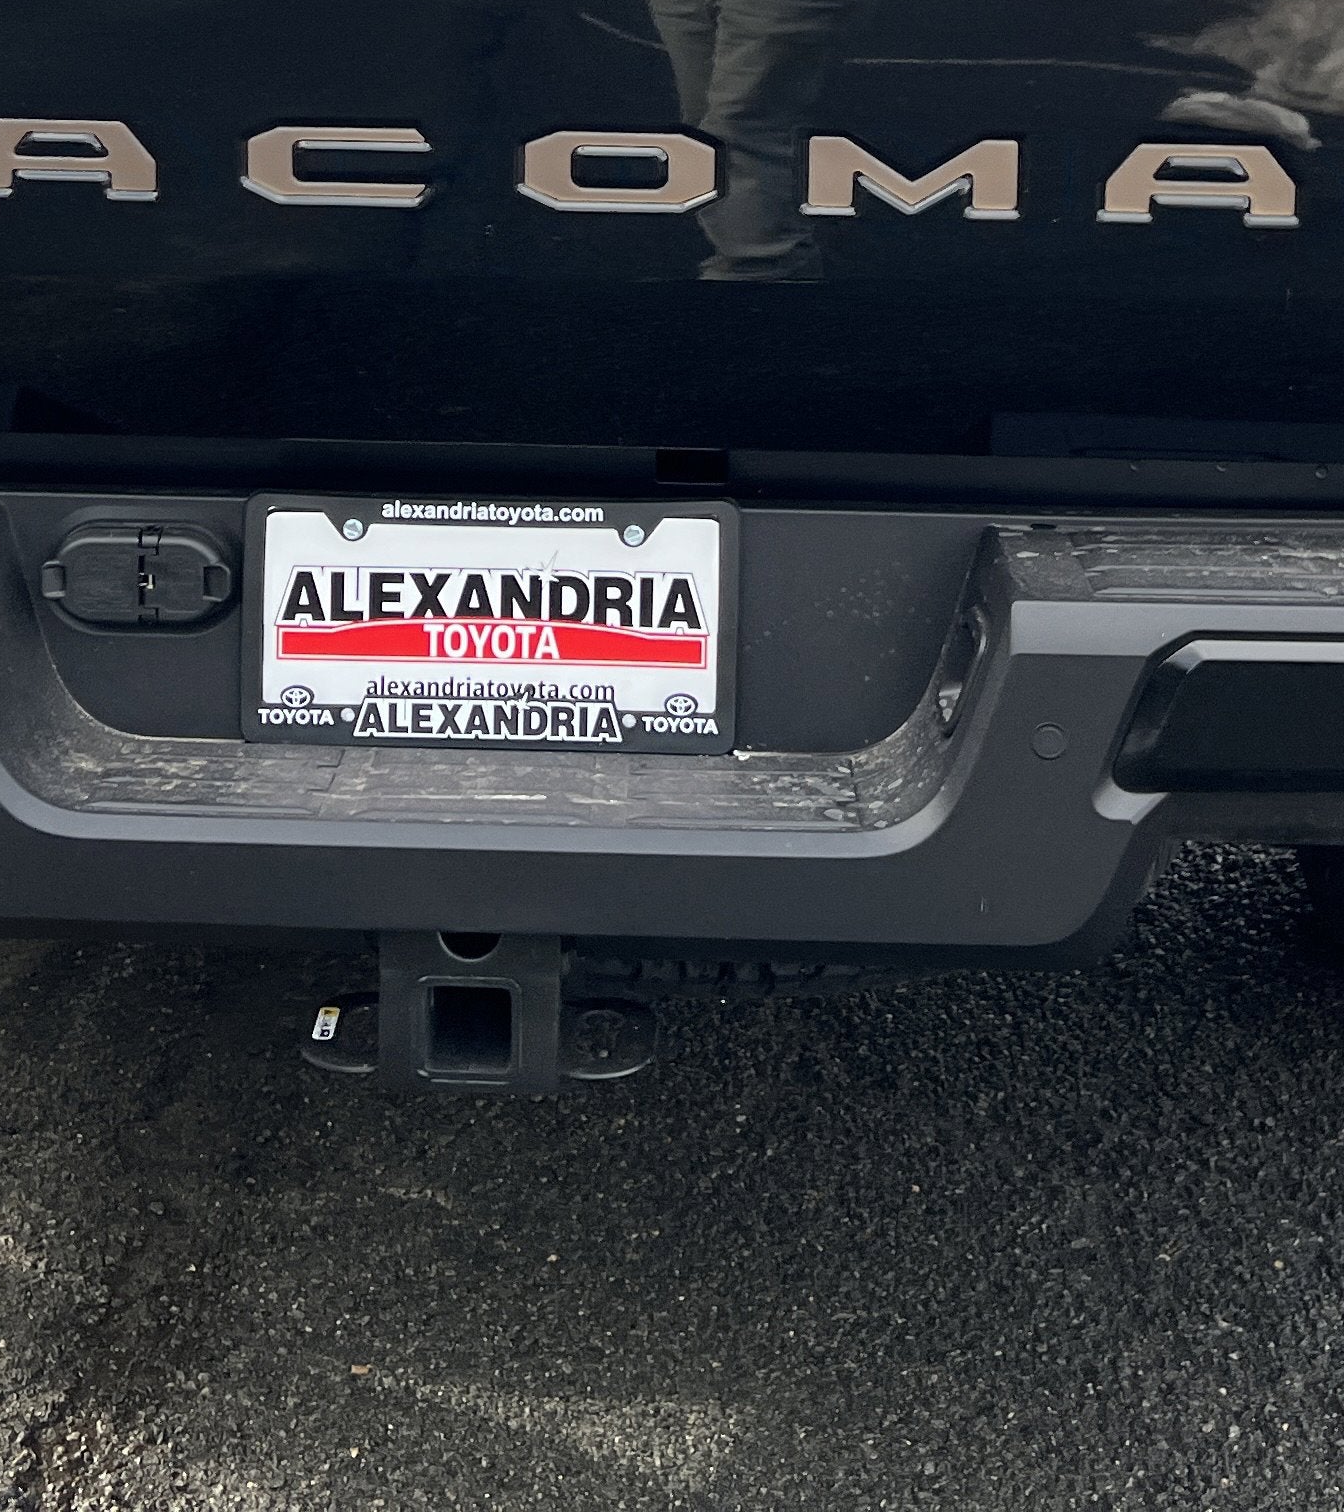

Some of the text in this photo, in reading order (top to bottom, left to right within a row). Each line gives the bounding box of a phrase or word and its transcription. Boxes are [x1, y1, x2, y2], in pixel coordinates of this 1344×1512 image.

[381, 499, 605, 525] alexandriatoyota.com
[280, 569, 703, 630] ALEXANDRIA
[422, 622, 561, 660] TOYOTA
[366, 675, 615, 701] alexandriatoyota.com
[258, 708, 335, 726] TOYOTA
[356, 700, 620, 740] ALEXANDRIA
[642, 715, 719, 736] TOYOTA
